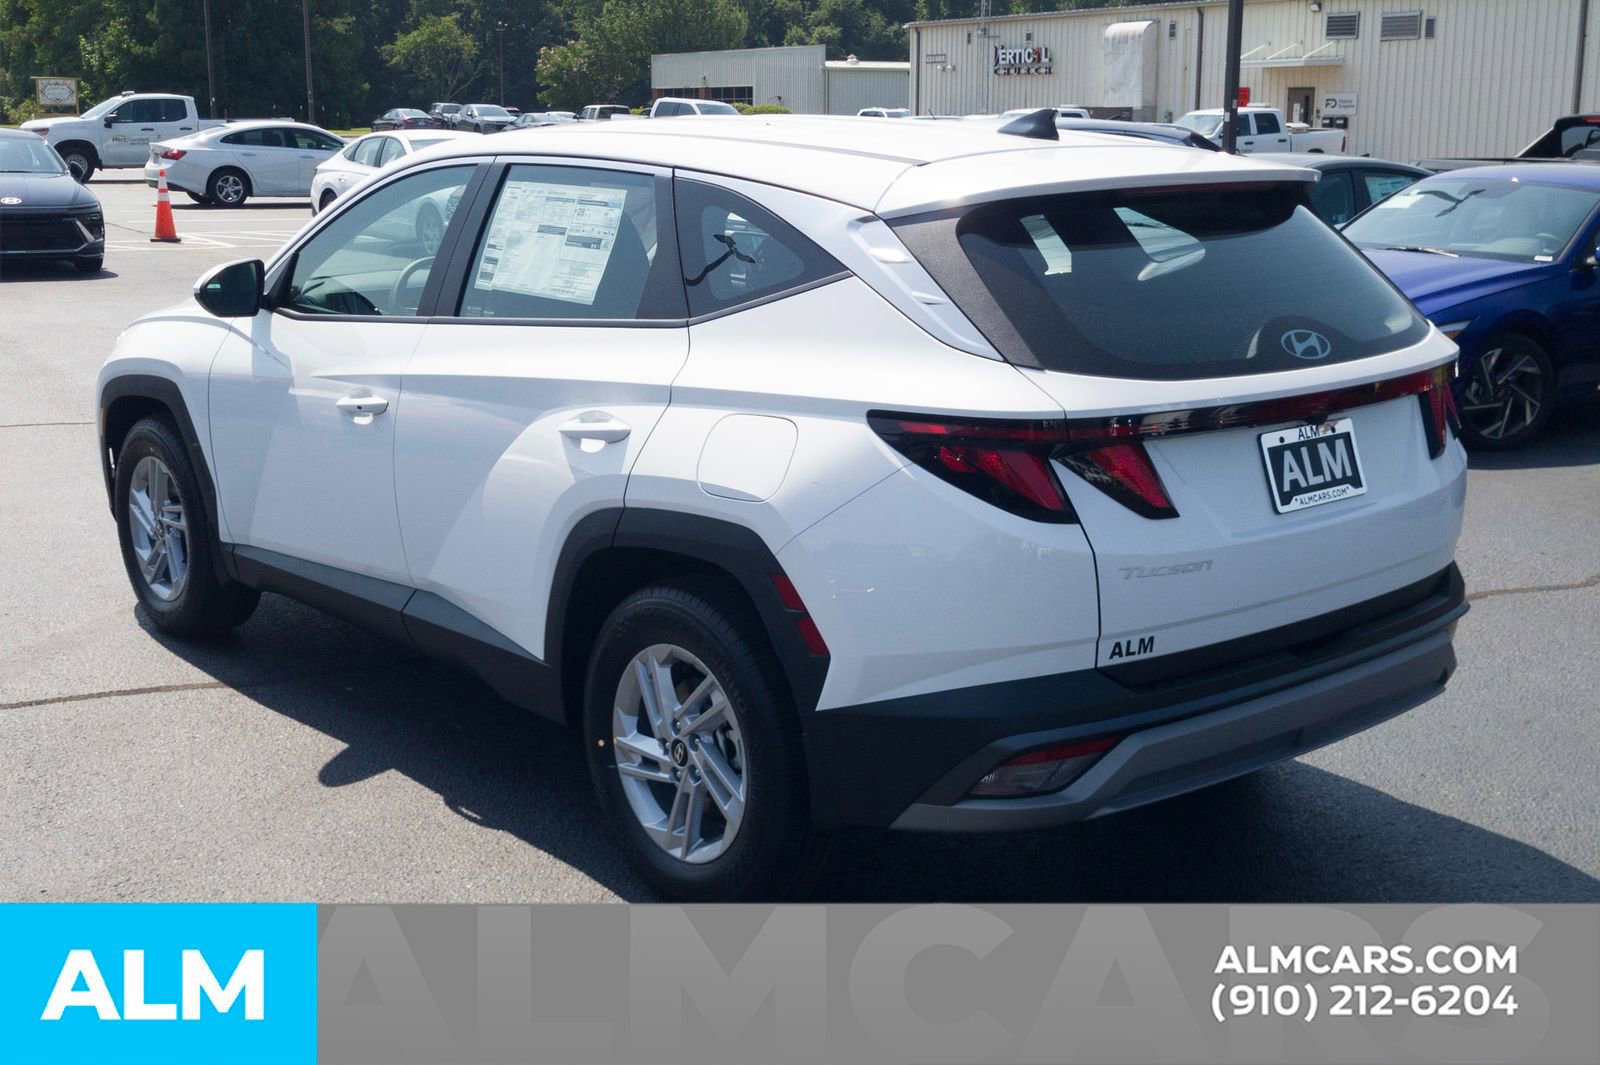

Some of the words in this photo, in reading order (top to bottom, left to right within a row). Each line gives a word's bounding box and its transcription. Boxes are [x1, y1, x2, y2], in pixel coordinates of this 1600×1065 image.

[994, 66, 1052, 76] CHURCH
[1298, 425, 1320, 441] ALM
[1283, 438, 1352, 492] ALM
[1300, 487, 1347, 505] ALMCARS.COM
[1109, 636, 1154, 659] ALM
